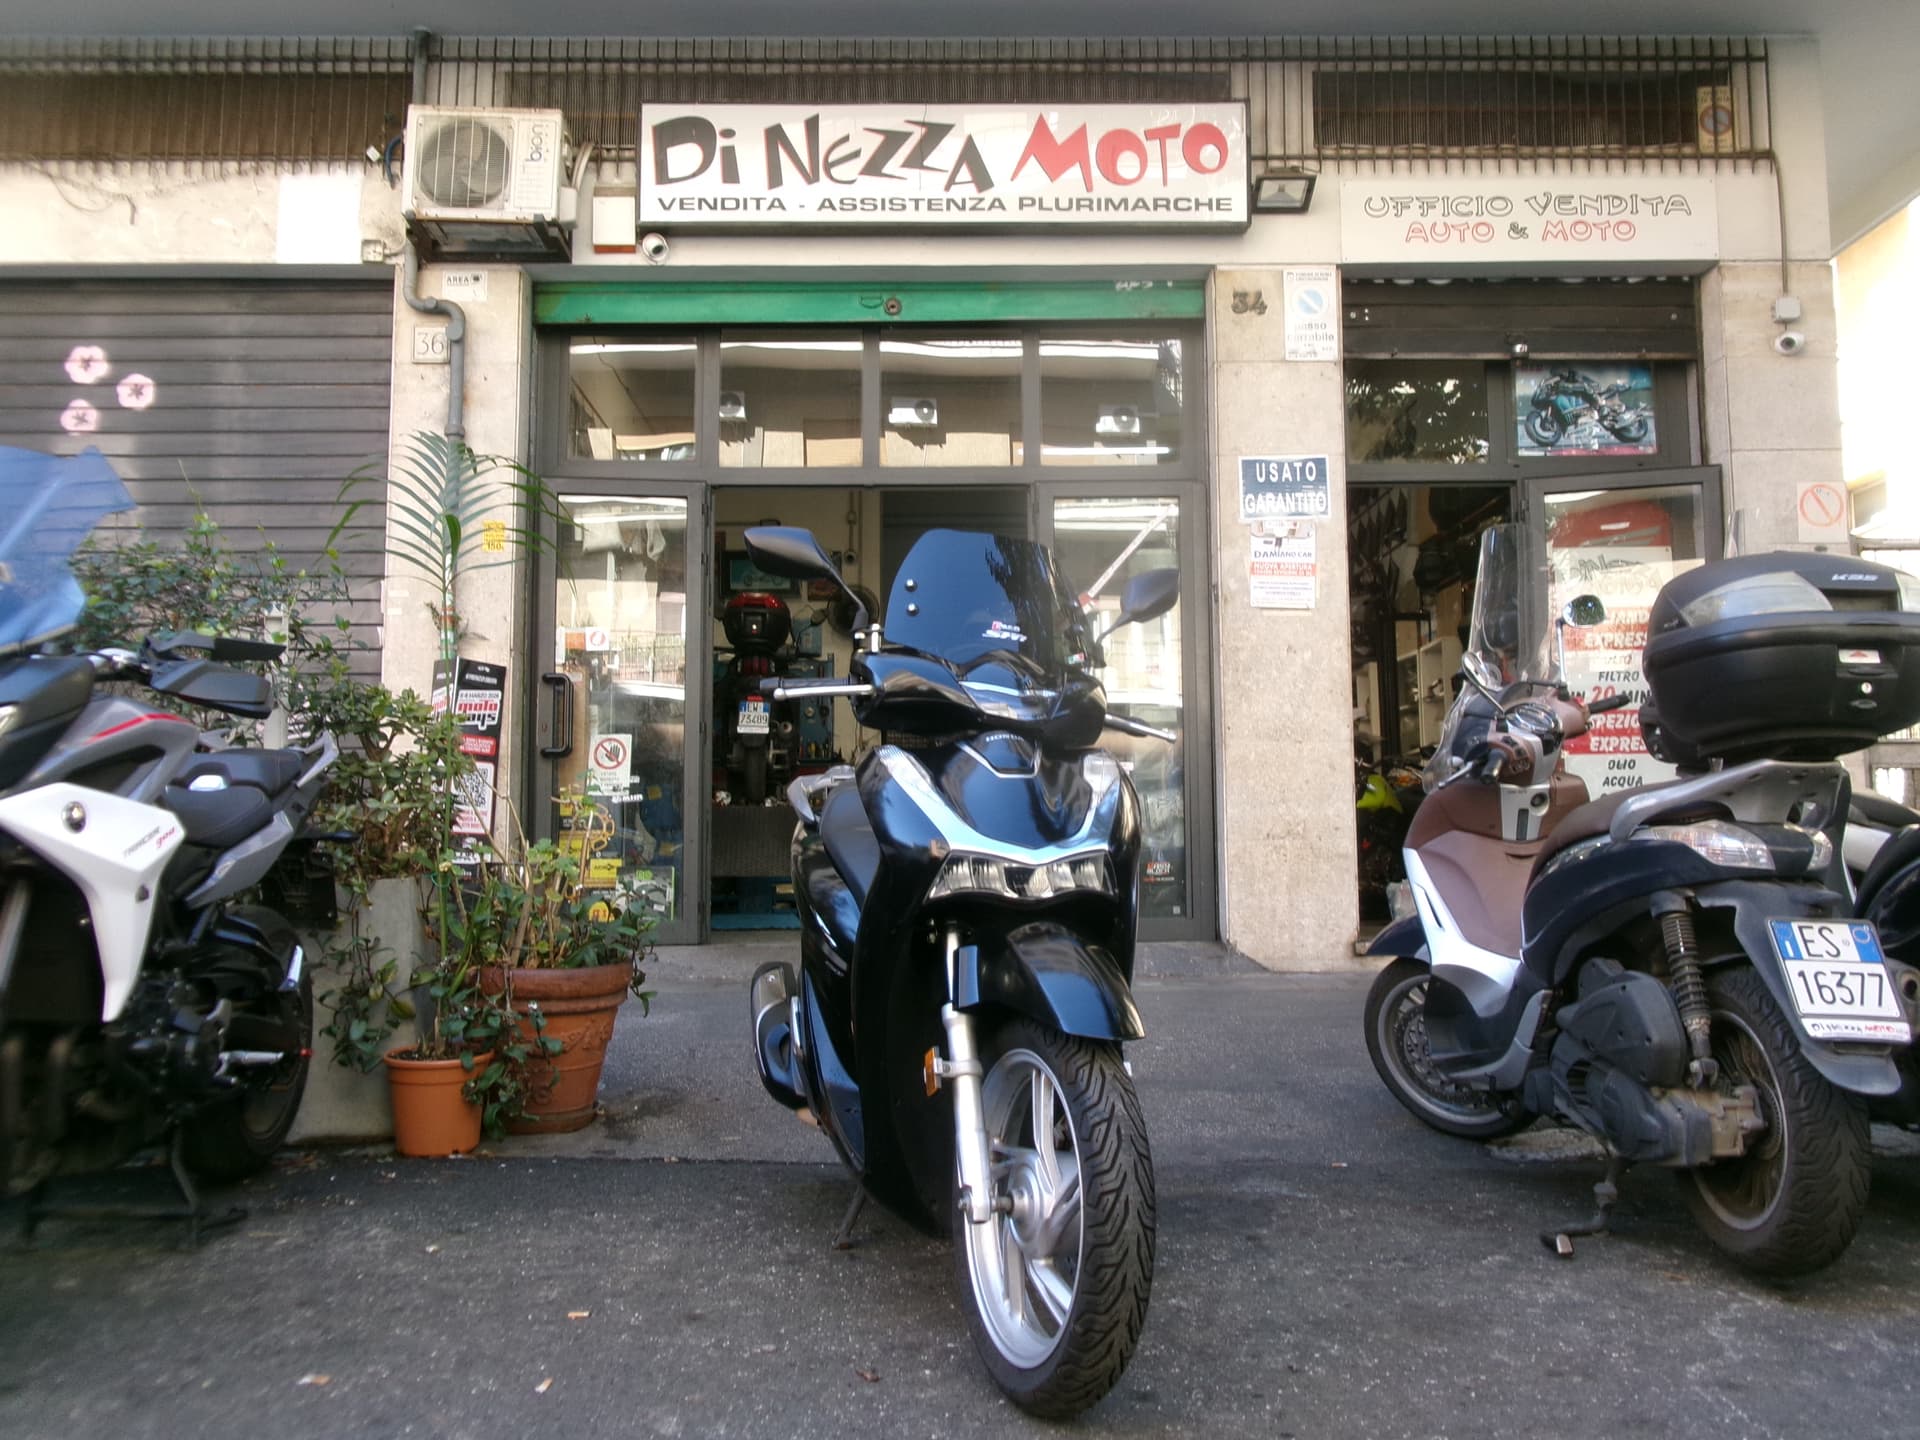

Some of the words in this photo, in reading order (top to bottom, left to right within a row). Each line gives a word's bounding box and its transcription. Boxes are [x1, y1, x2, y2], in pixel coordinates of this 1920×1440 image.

[1010, 111, 1229, 193] MOTO
[656, 196, 787, 212] VENDITA
[816, 196, 1007, 213] ASSISTENZA
[1017, 196, 1233, 213] PLURIMARCHE
[1364, 195, 1514, 218] UFFICIO
[1524, 192, 1693, 217] VENDITA
[1404, 220, 1495, 243] AUTO
[1506, 222, 1529, 240] &
[1541, 219, 1637, 242] MOTO
[446, 275, 470, 286] AREA
[1231, 290, 1268, 315] 34
[416, 331, 446, 356] 36
[1255, 461, 1317, 483] USATO
[1245, 491, 1327, 514] GARANTITO
[1598, 670, 1640, 682] FILTRO
[1607, 759, 1637, 770] OLIO
[1602, 775, 1643, 788] ACQUA
[1797, 925, 1841, 958] ES
[1797, 970, 1884, 1008] 16377
